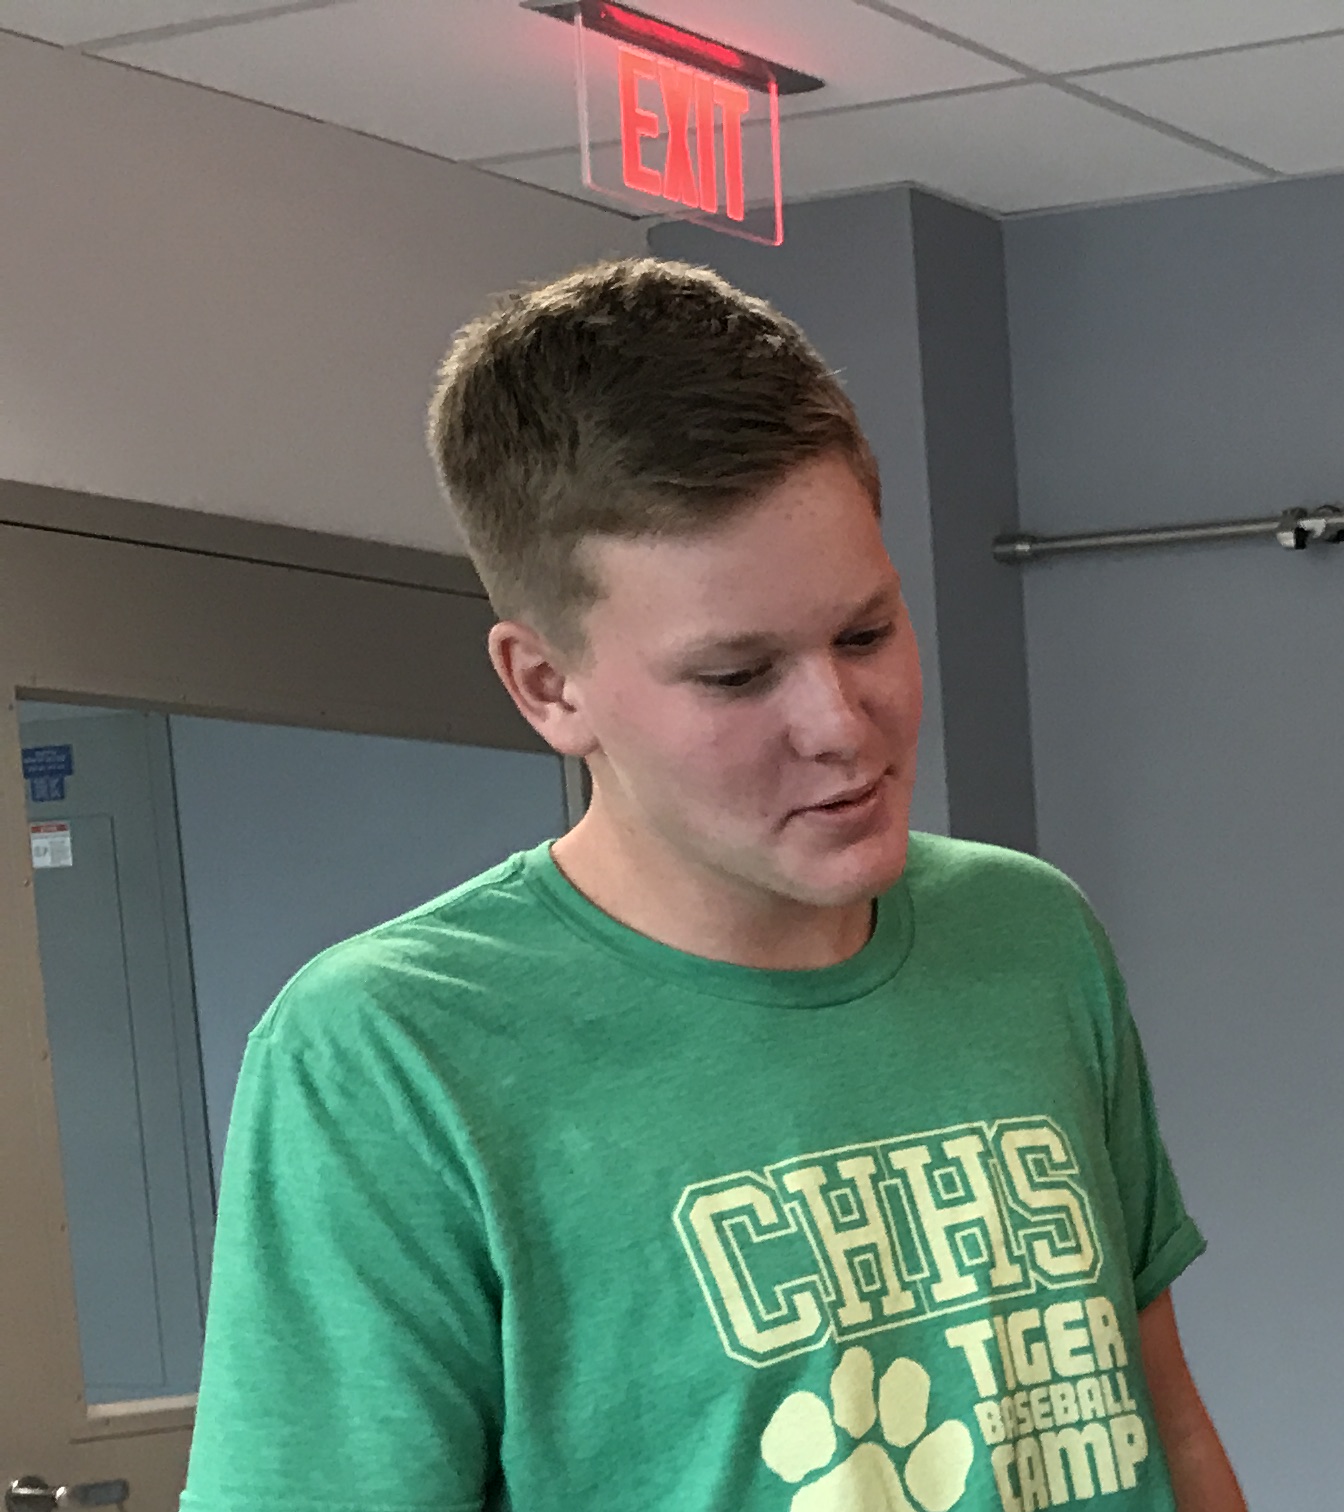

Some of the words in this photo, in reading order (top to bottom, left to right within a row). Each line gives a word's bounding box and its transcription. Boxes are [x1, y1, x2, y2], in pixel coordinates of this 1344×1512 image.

[618, 44, 749, 222] EXIT
[673, 1115, 1104, 1369] CHHS
[944, 1296, 1129, 1399] TIGER
[973, 1372, 1137, 1446] BASEBALL
